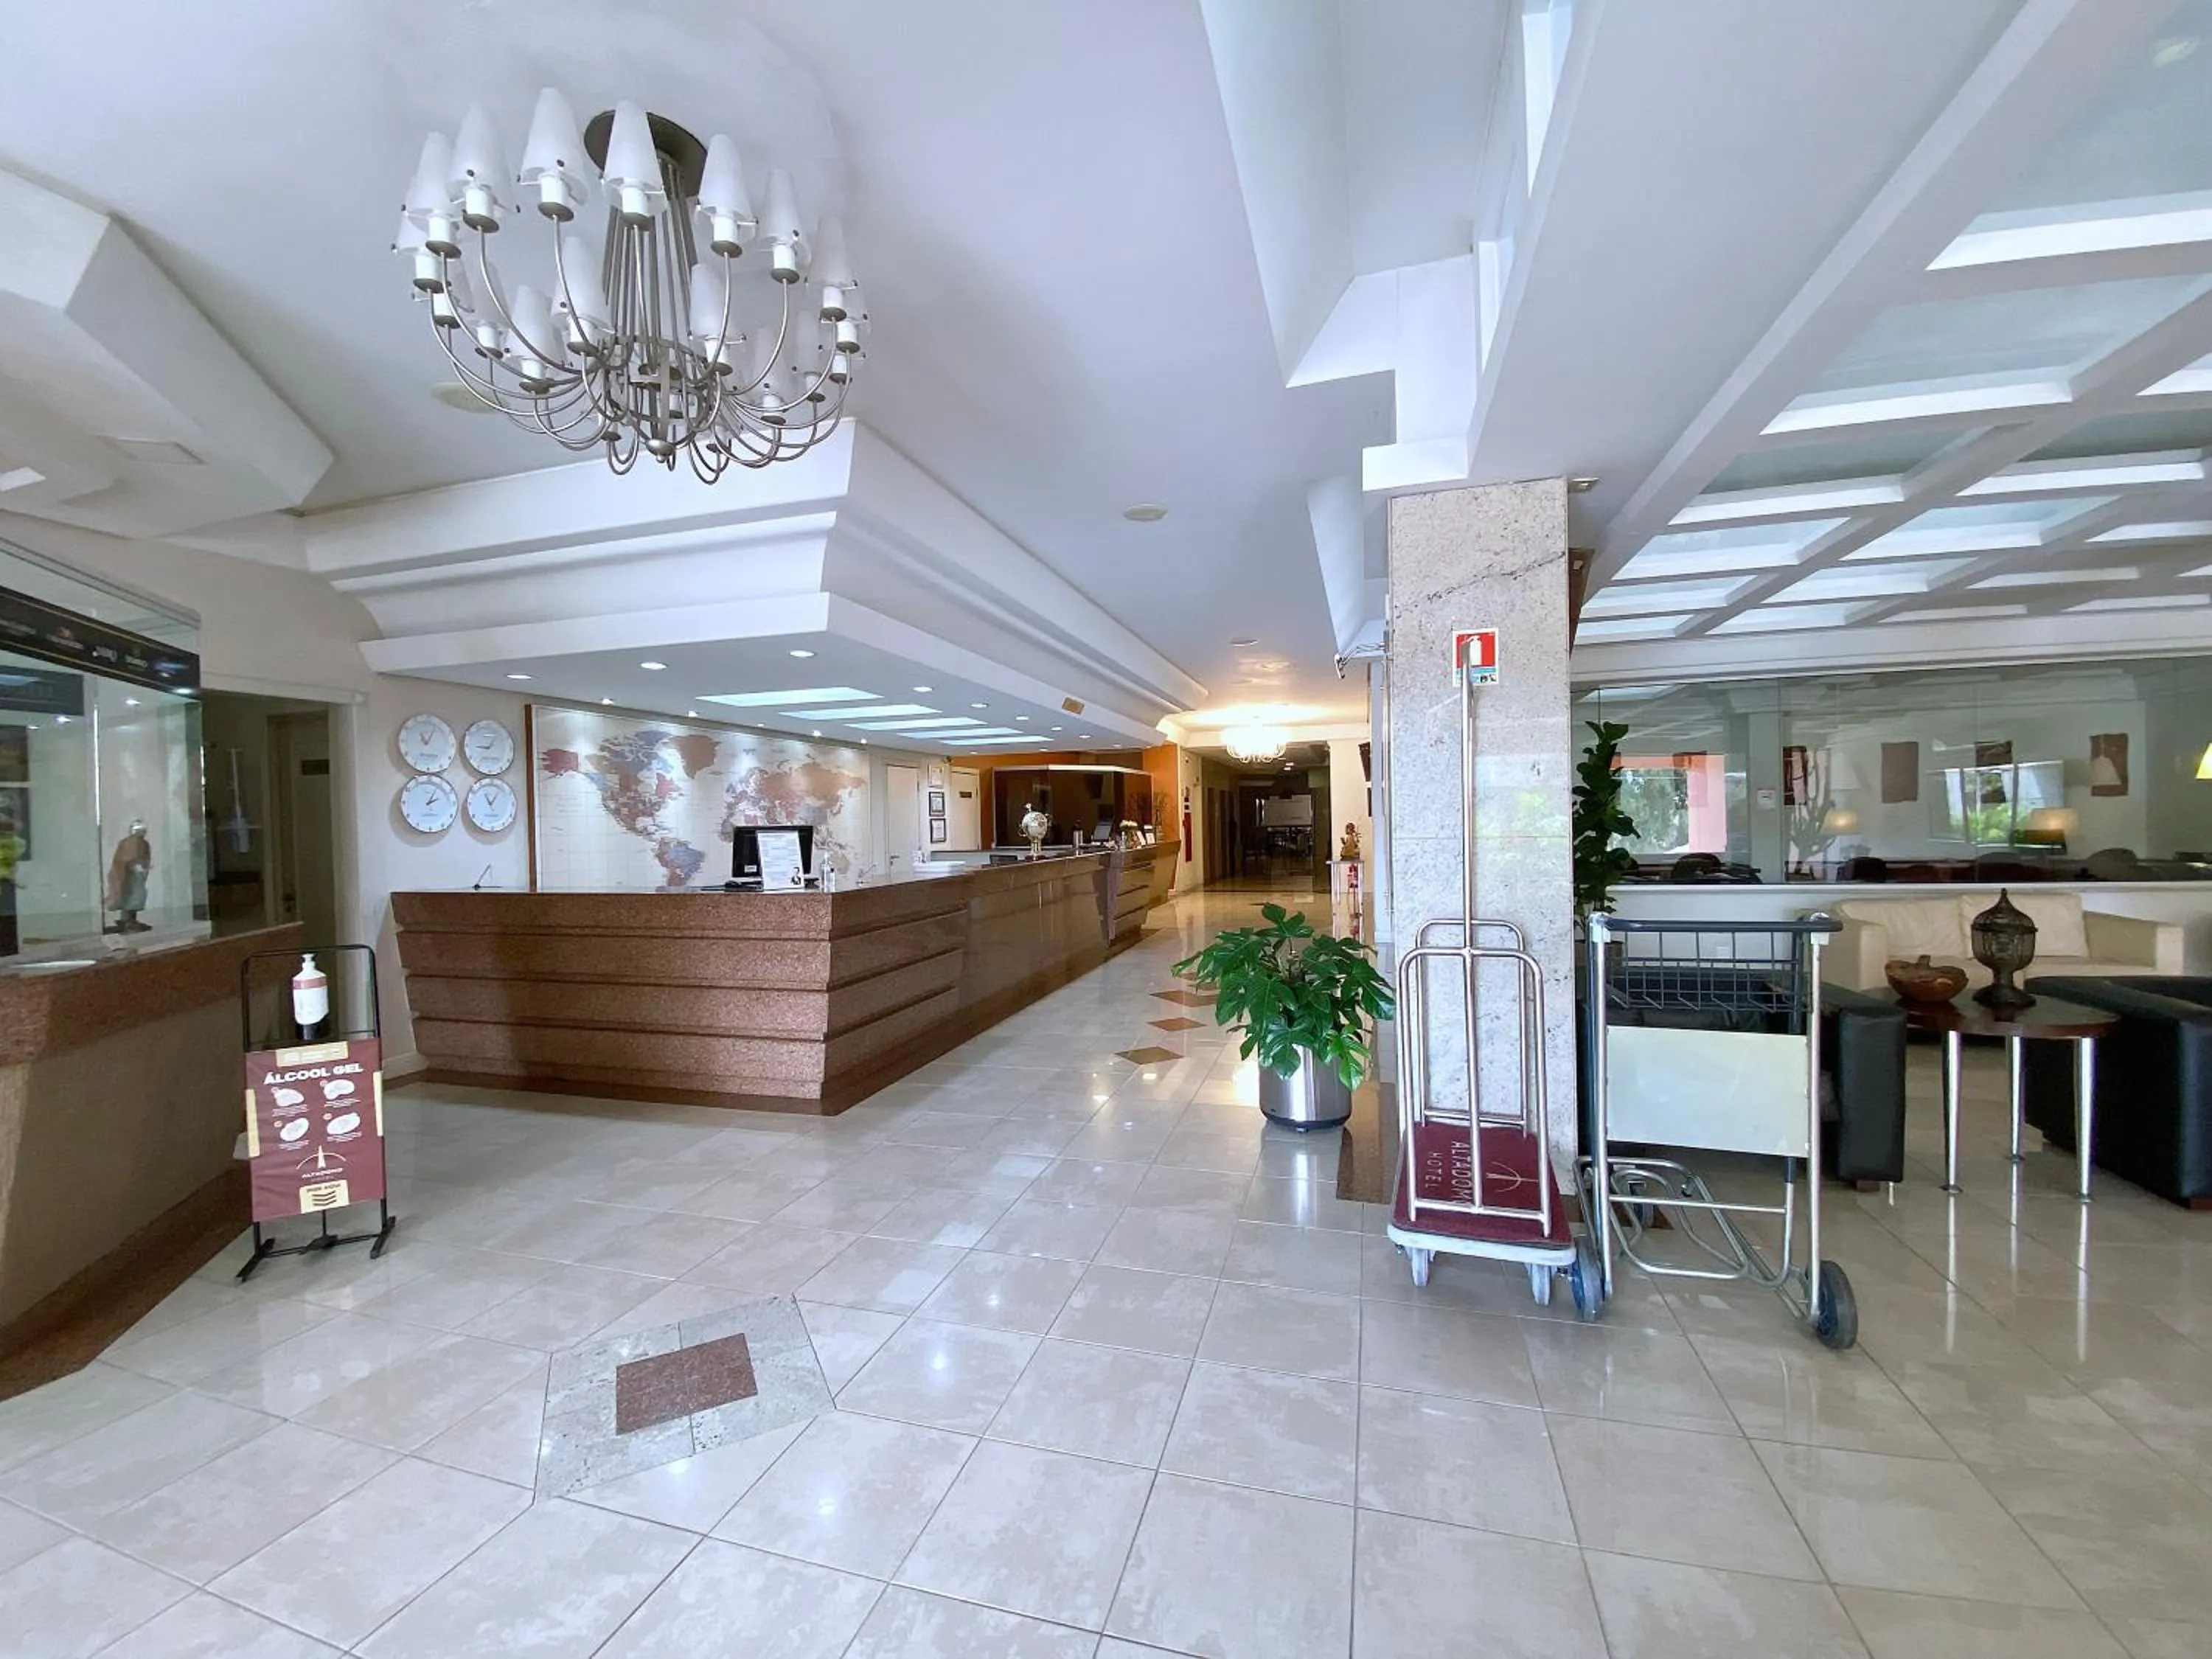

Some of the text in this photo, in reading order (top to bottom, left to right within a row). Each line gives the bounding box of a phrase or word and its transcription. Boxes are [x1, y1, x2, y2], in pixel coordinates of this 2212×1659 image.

[263, 1062, 364, 1085] ÁLCOOL GEL
[1425, 1150, 1443, 1189] HOTEL
